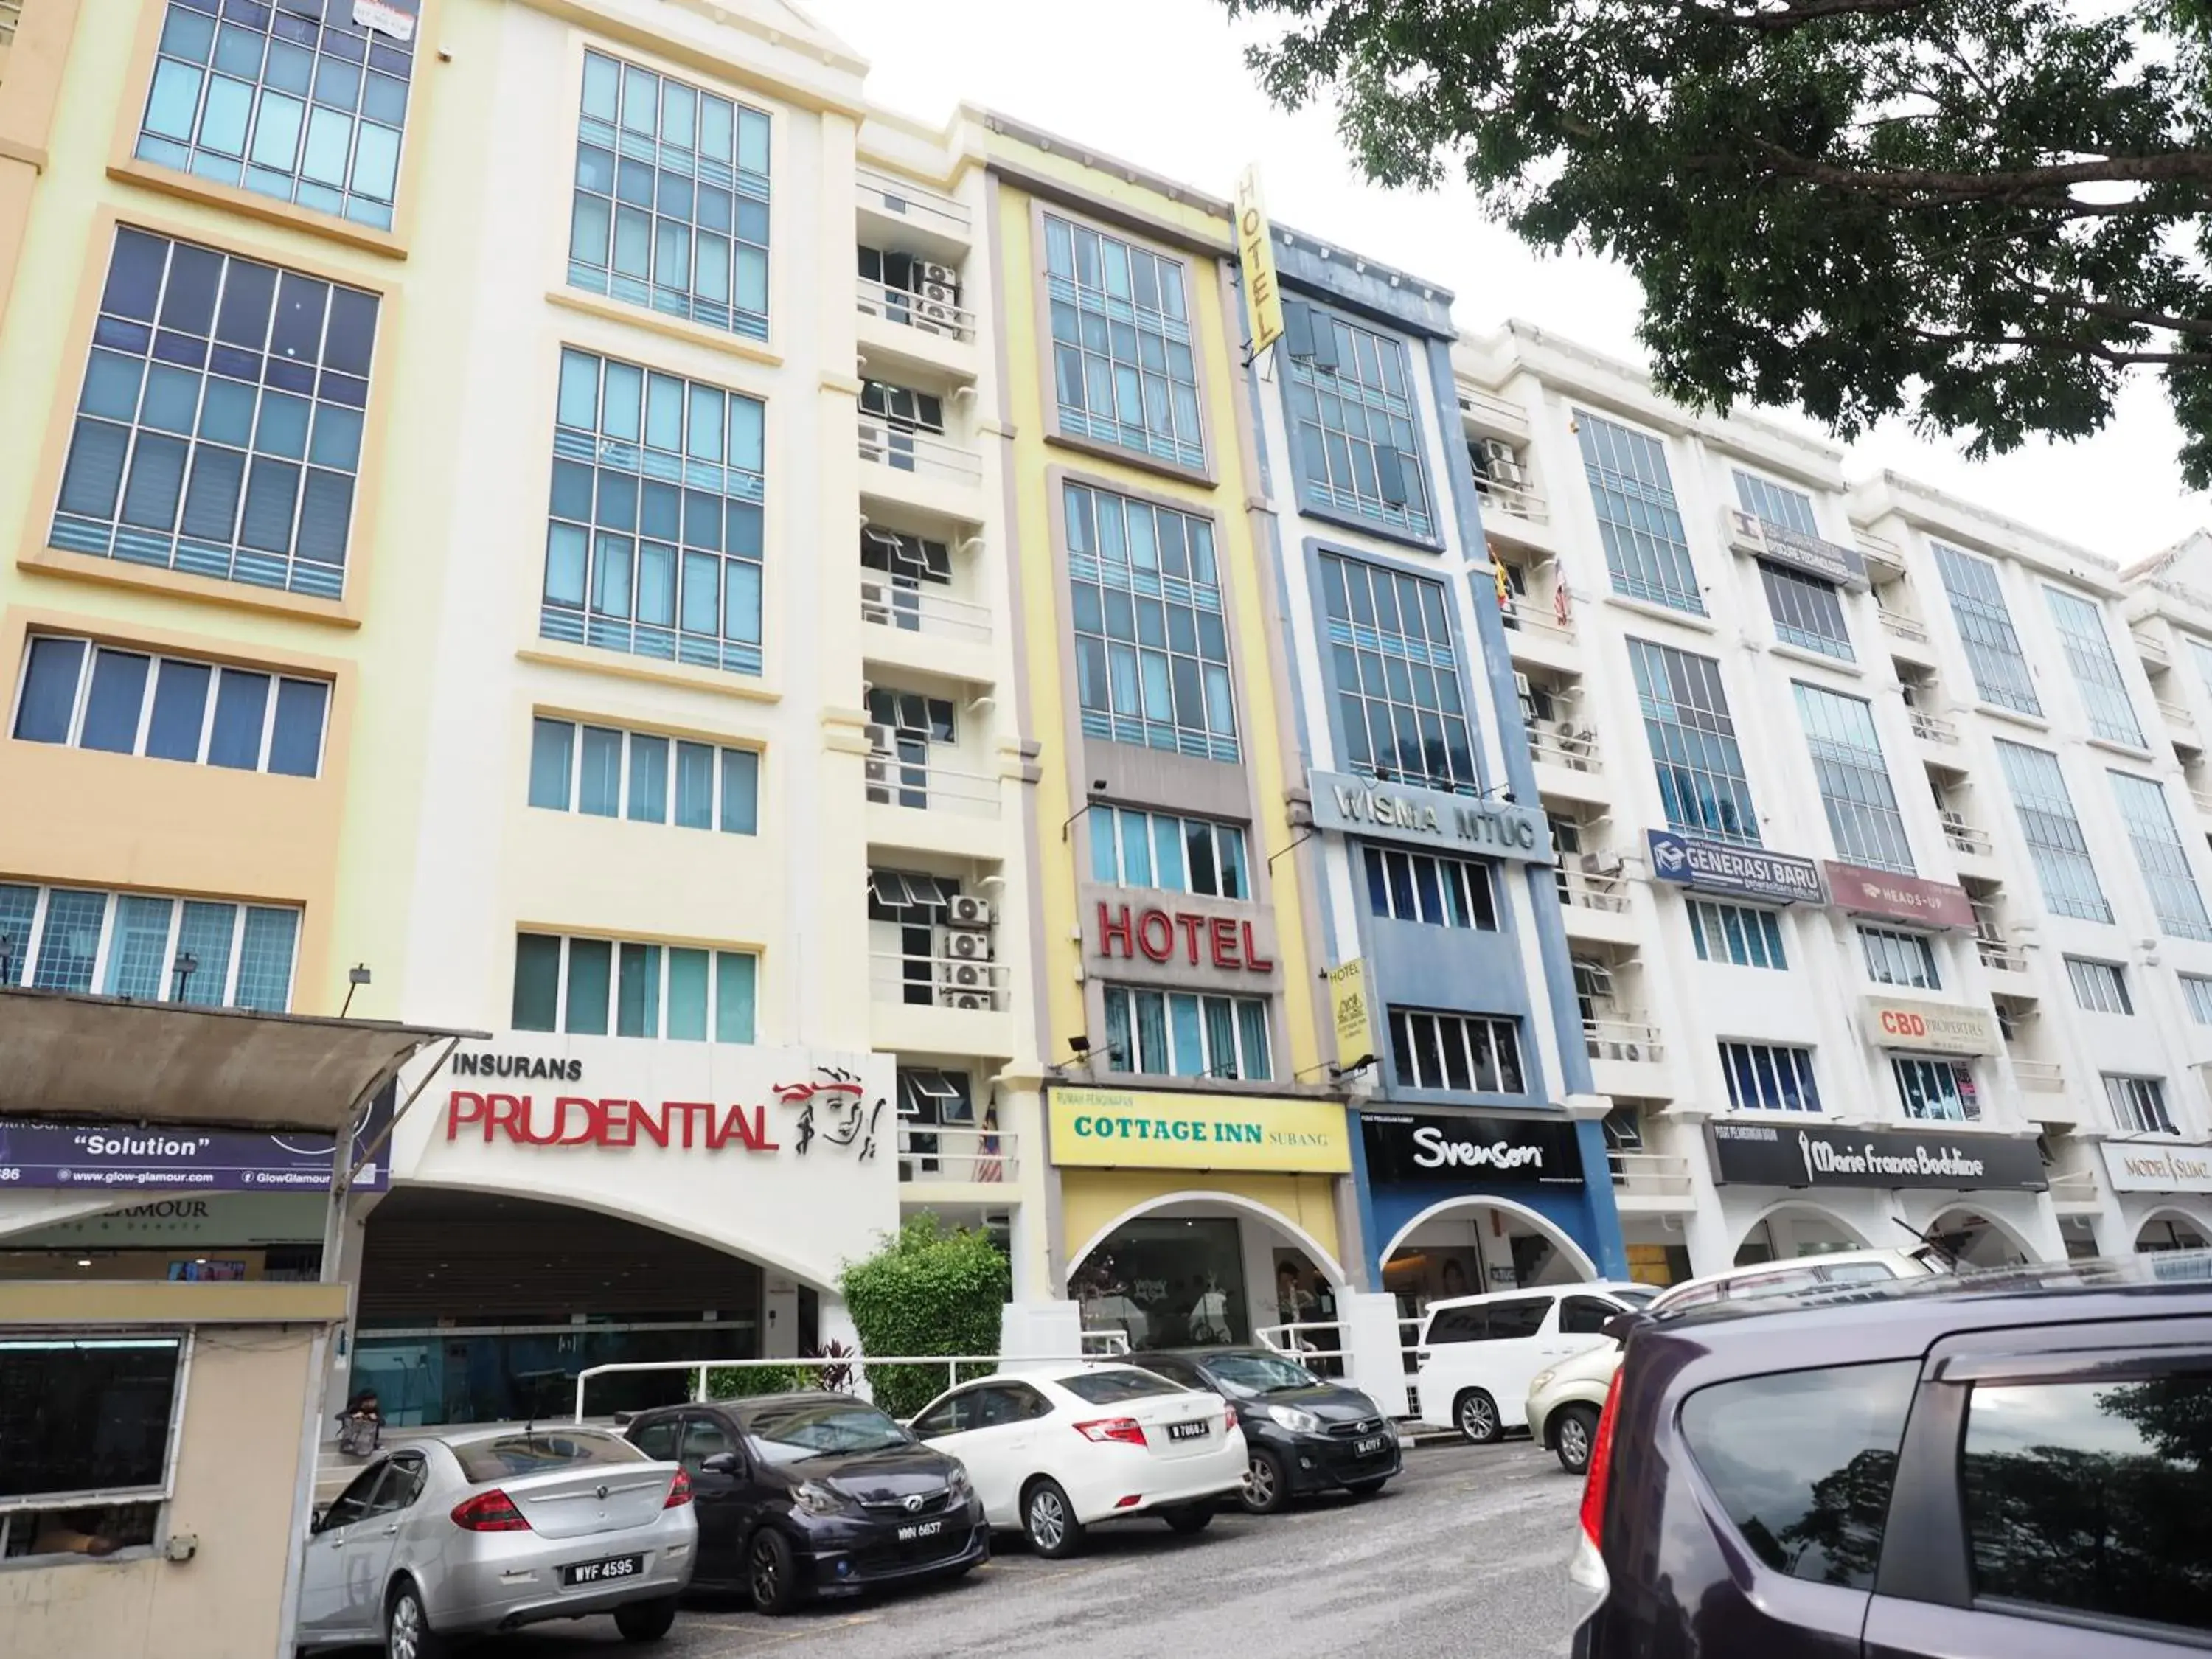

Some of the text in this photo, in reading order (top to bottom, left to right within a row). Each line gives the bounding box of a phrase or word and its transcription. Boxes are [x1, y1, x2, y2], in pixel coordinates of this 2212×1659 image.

[1239, 172, 1275, 343] HOTEL
[1333, 785, 1534, 849] WISMA MTUC
[1686, 847, 1771, 882] GENERASI
[1773, 862, 1818, 888] BARU
[1882, 886, 1942, 910] HEADS-UP
[1096, 901, 1274, 973] HOTEL
[1329, 963, 1360, 985] HOTEL
[1880, 1010, 1984, 1037] CBD PROPERTIES
[452, 1052, 583, 1082] INSURANS
[446, 1090, 780, 1152] PRUDENTIAL
[1074, 1116, 1329, 1147] COTTAGE INN SUBANG
[1413, 1127, 1543, 1169] Svenson
[1811, 1140, 1983, 1177] Marie France Bodyline
[73, 1171, 214, 1183] www.glow-glamour.com
[257, 1172, 331, 1184] GlowGlamour
[2124, 1156, 2169, 1178] MODEL
[576, 1559, 633, 1582] WYF 4595
